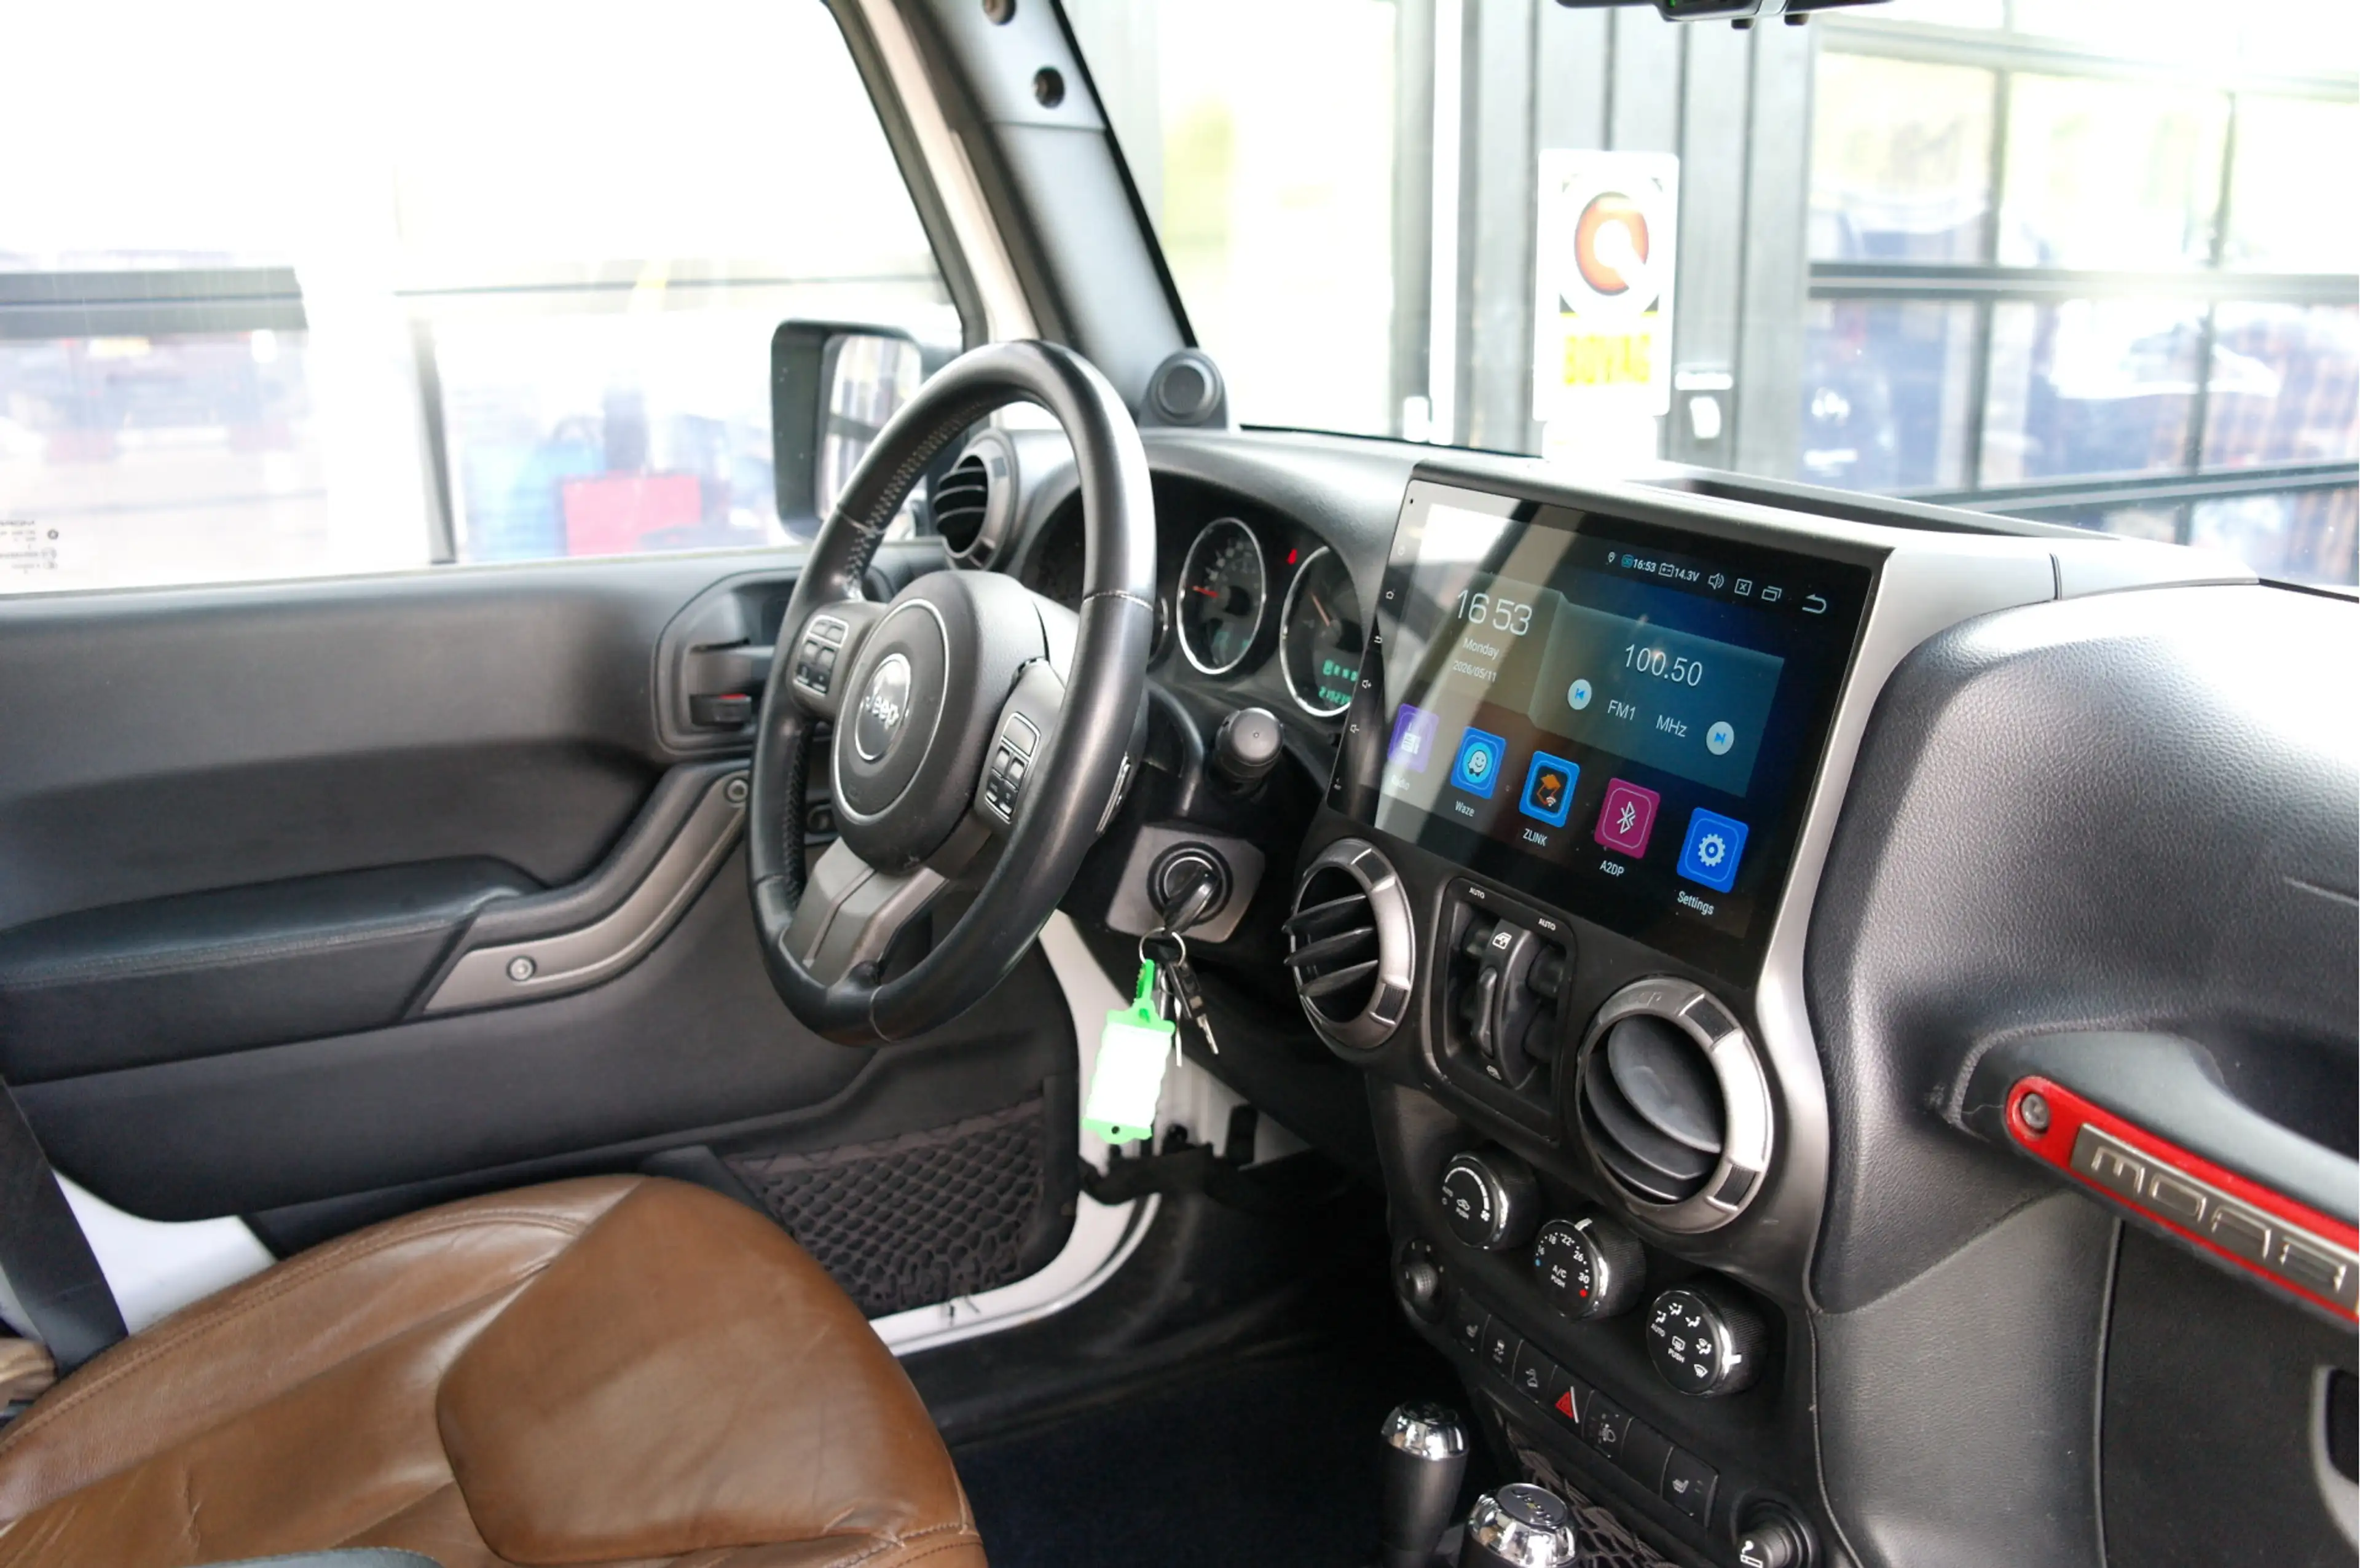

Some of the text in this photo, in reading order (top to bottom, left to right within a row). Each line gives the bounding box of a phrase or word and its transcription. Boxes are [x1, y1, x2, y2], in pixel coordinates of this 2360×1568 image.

[1633, 559, 1657, 573] 16:53
[1674, 568, 1701, 582] 14.3V
[1463, 637, 1500, 661] Monday
[1625, 644, 1703, 687] 100.50
[1607, 699, 1636, 721] FM1
[1656, 715, 1688, 737] MHz
[1455, 800, 1476, 818] Waze
[1523, 828, 1548, 846] ZLINK
[1599, 860, 1624, 877] A2DP
[1469, 887, 1485, 900] AUTO
[1677, 891, 1715, 915] Settings
[1538, 917, 1556, 931] AUTO
[1562, 1234, 1572, 1246] 22
[1573, 1250, 1584, 1261] 26
[1552, 1264, 1567, 1279] A/C
[1578, 1272, 1590, 1284] 30
[1668, 1348, 1685, 1363] PUSH
